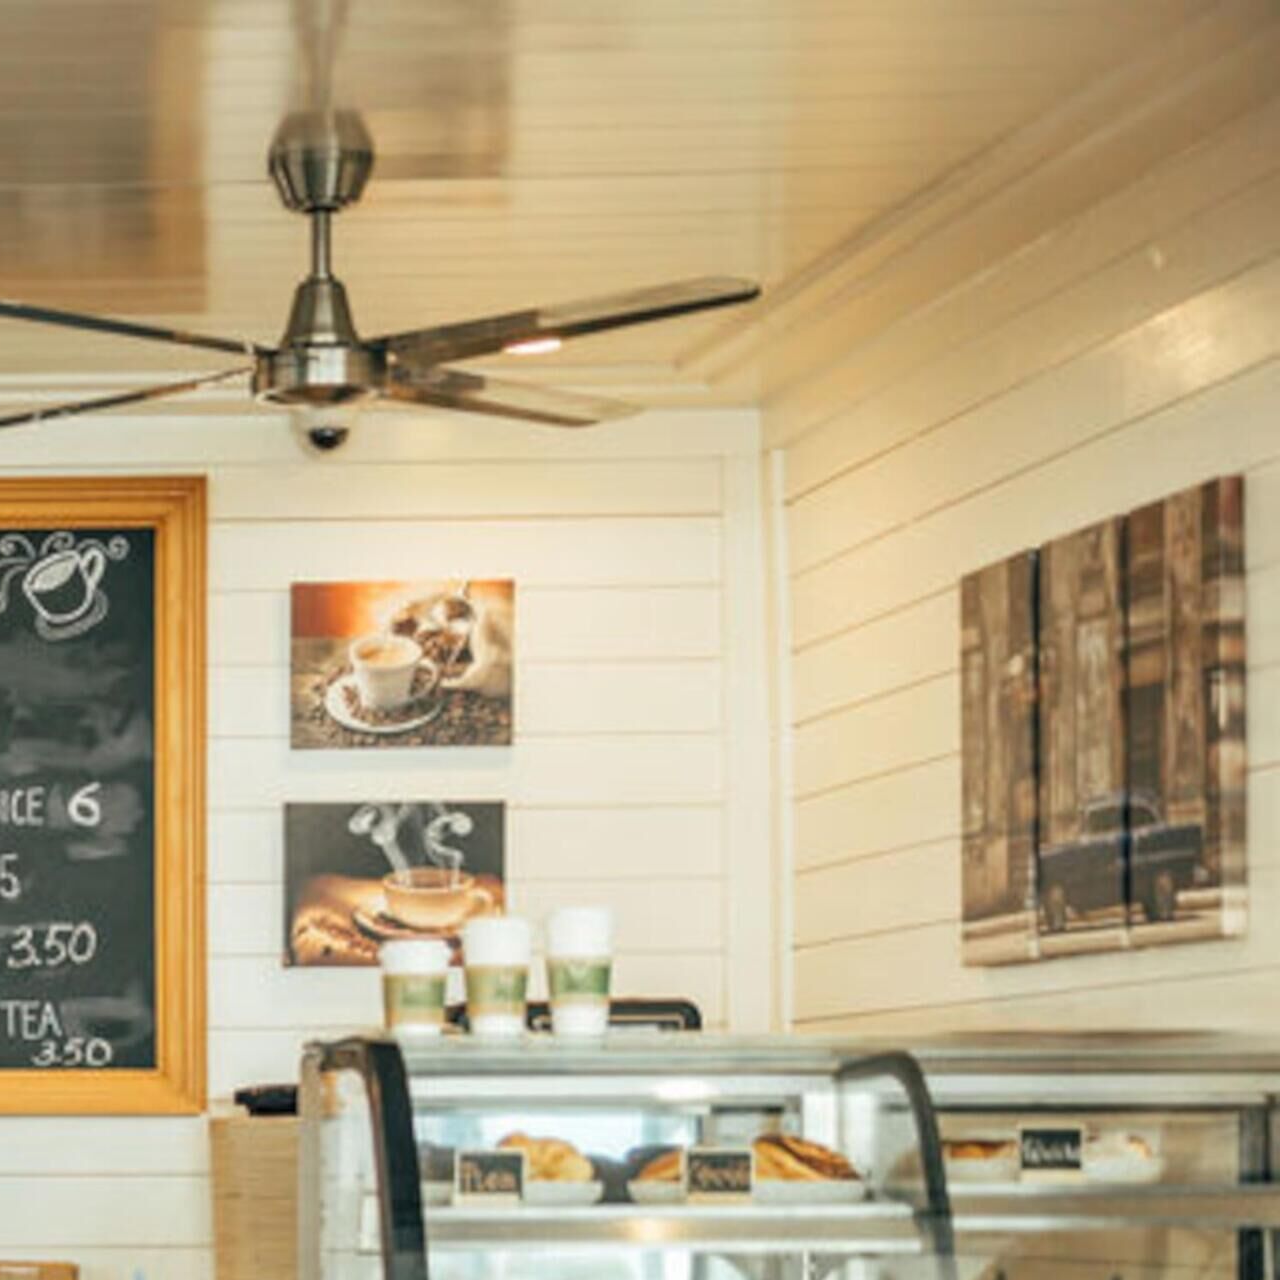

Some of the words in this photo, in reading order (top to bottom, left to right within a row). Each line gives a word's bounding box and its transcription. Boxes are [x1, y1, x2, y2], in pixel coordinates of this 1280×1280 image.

[66, 781, 102, 827] 6
[6, 921, 98, 970] 3.50
[31, 1038, 112, 1067] 3.50
